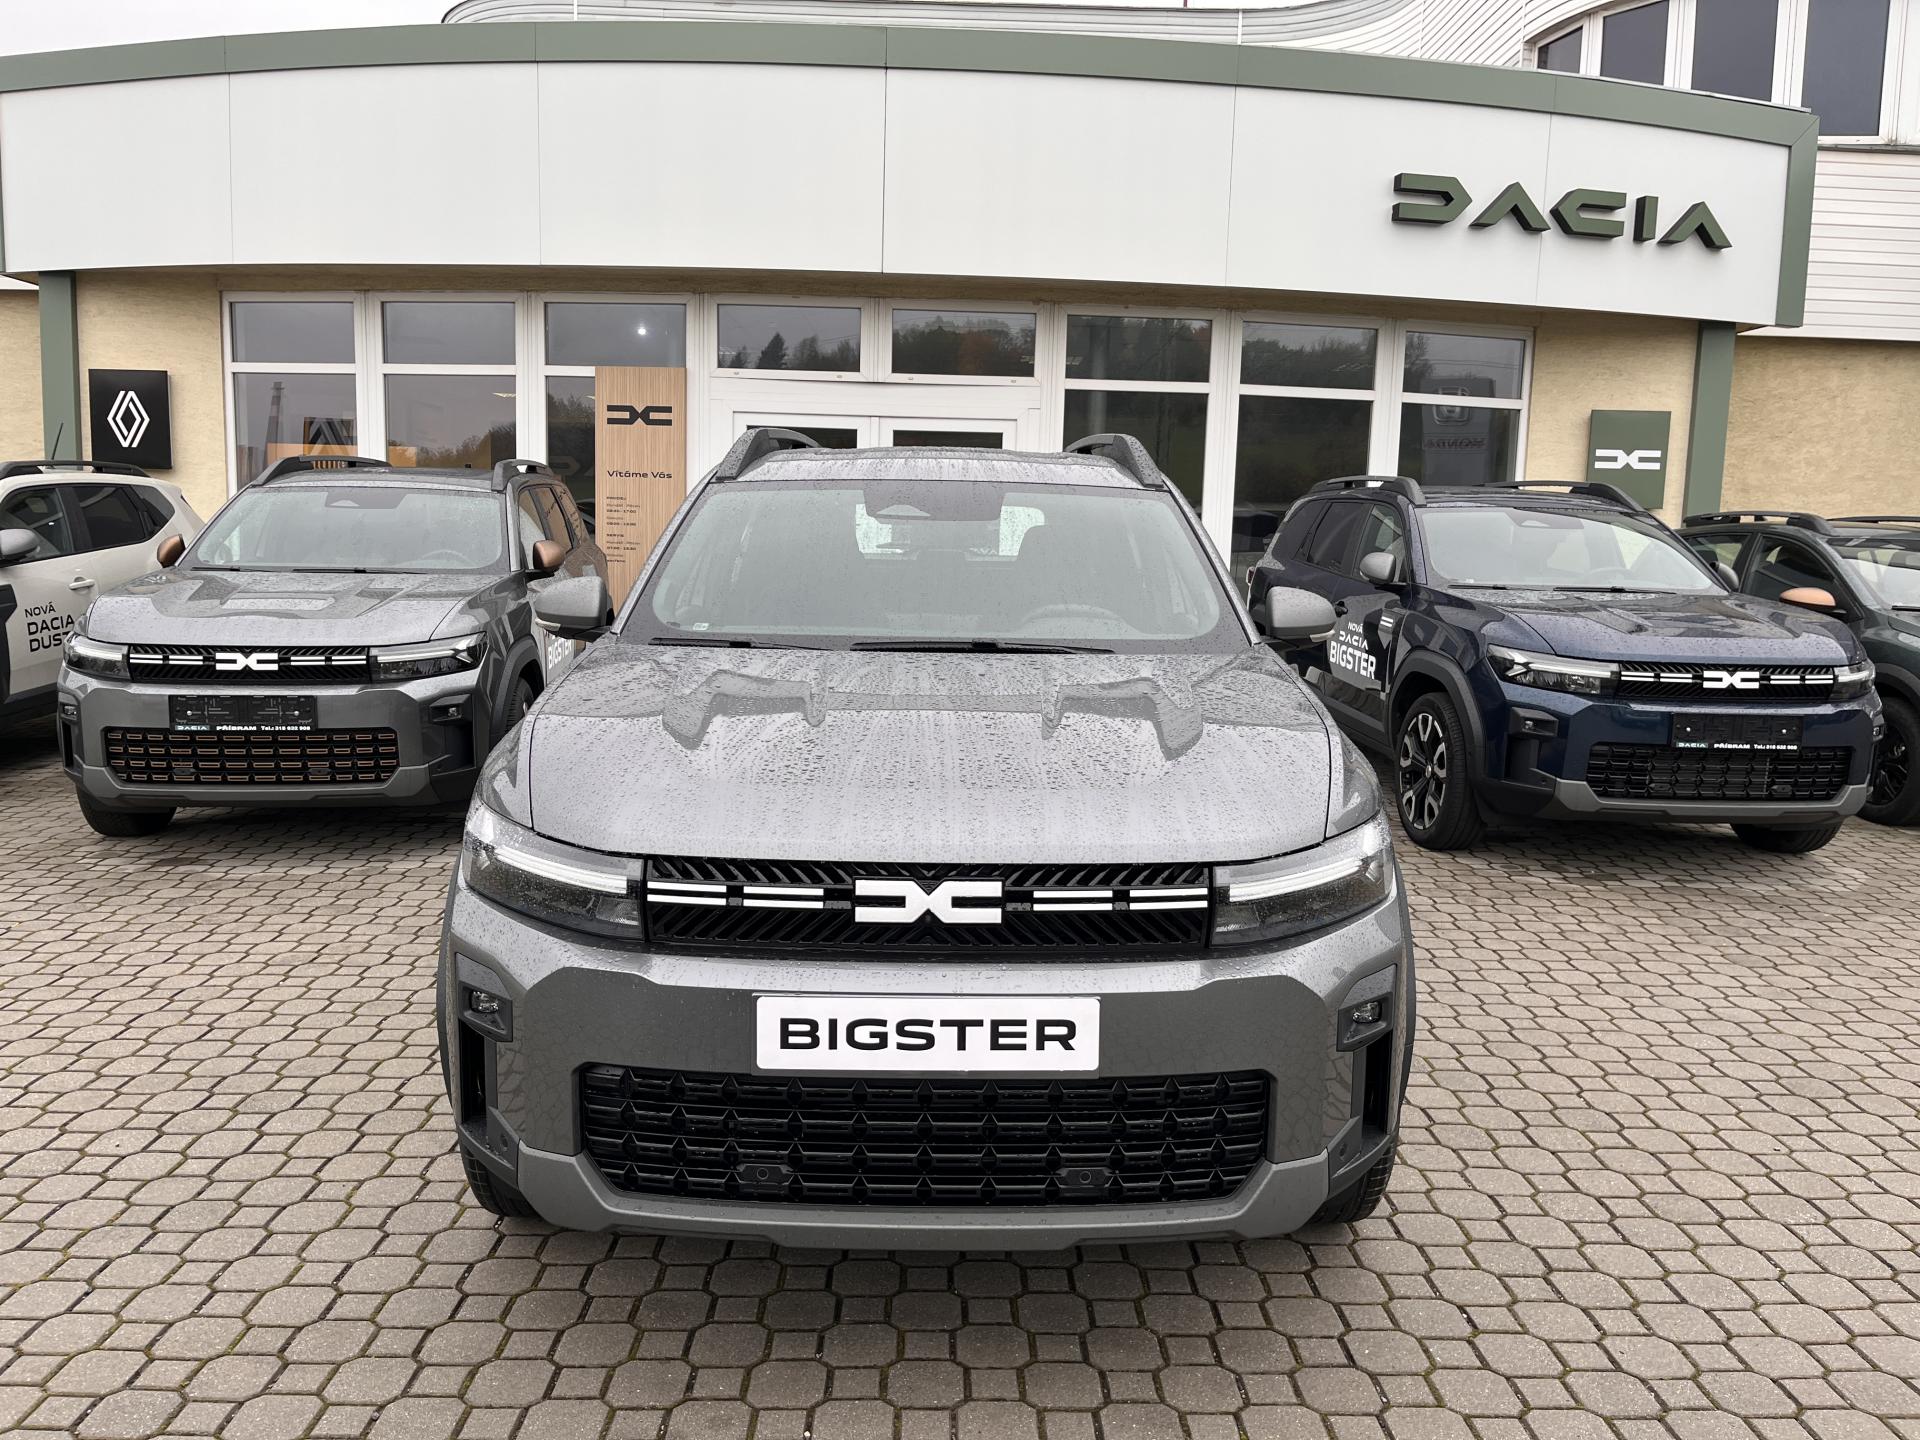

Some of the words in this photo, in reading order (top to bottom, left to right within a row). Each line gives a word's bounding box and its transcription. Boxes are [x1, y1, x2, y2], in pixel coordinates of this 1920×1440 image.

[1392, 173, 1733, 250] DACIA
[651, 471, 672, 479] Vás
[24, 601, 56, 618] NOVÁ
[27, 614, 75, 636] DACIA
[1338, 630, 1369, 650] DACIA
[1329, 640, 1377, 680] BIGSTER
[779, 1017, 1077, 1052] BIGSTER
